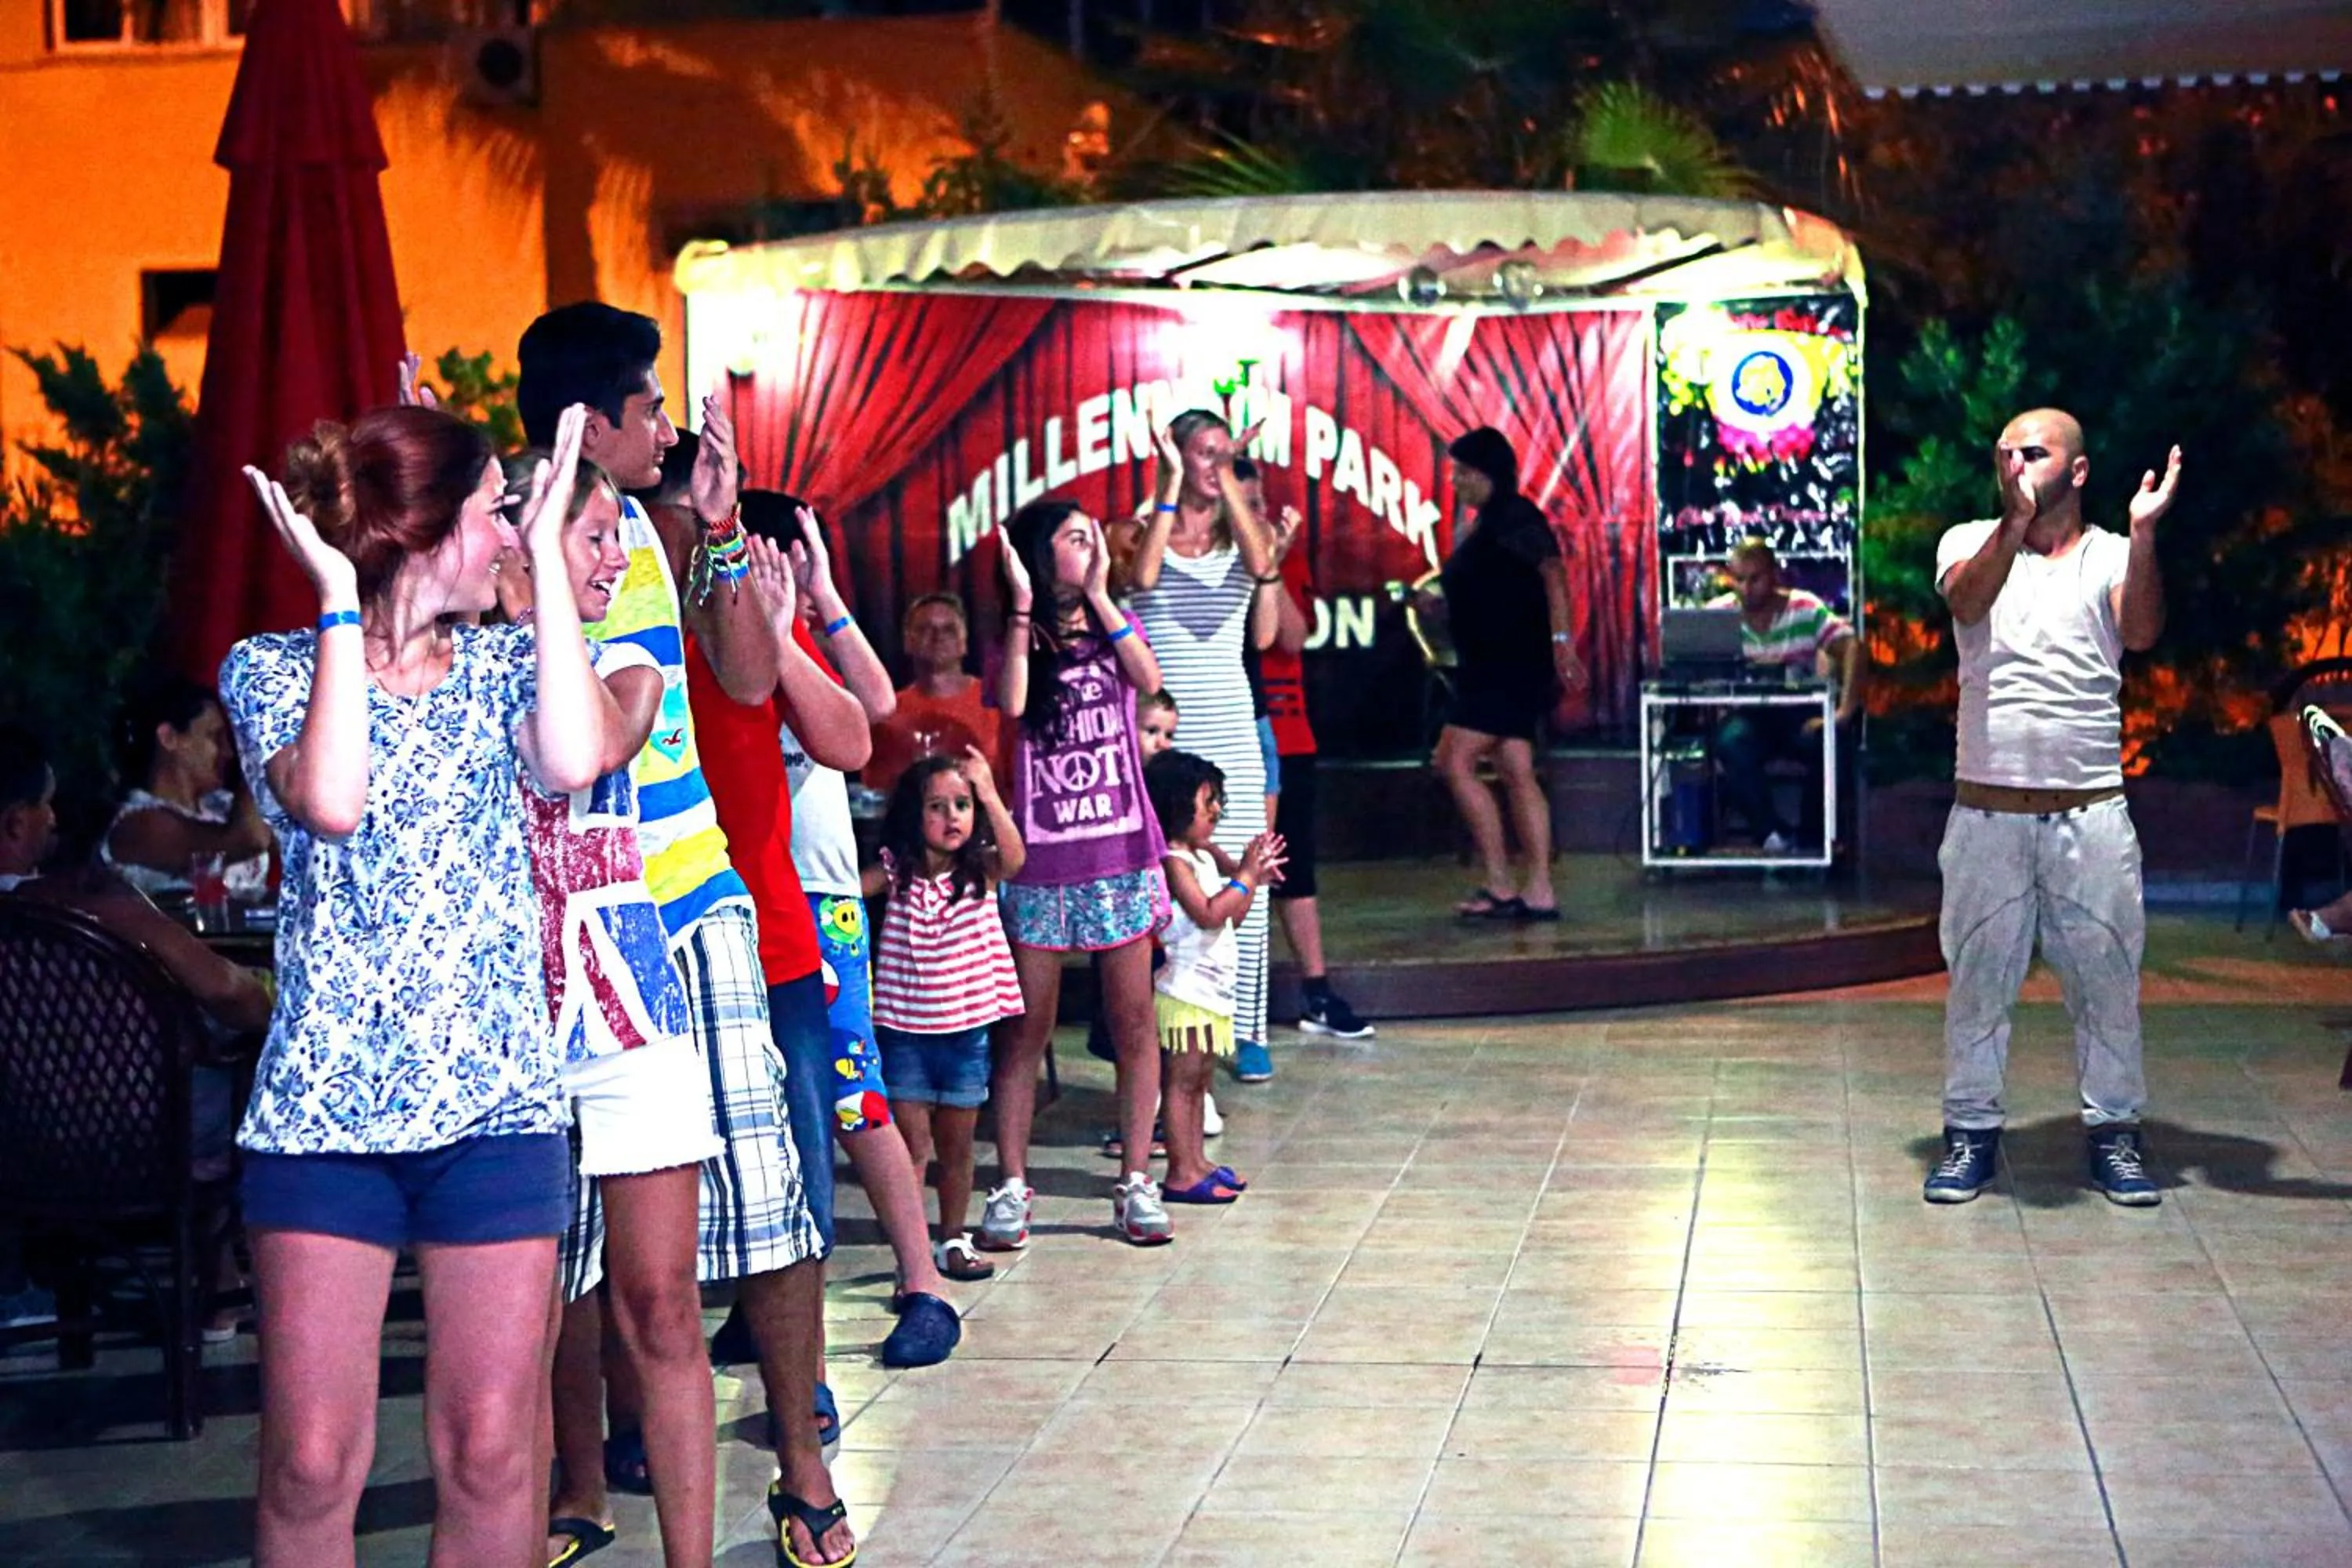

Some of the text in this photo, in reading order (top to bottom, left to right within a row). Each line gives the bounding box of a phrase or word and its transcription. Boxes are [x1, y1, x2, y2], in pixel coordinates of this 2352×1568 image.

[949, 379, 1441, 568] MILLENM PARK
[1033, 744, 1122, 798] NOT
[1053, 793, 1113, 824] WAR
